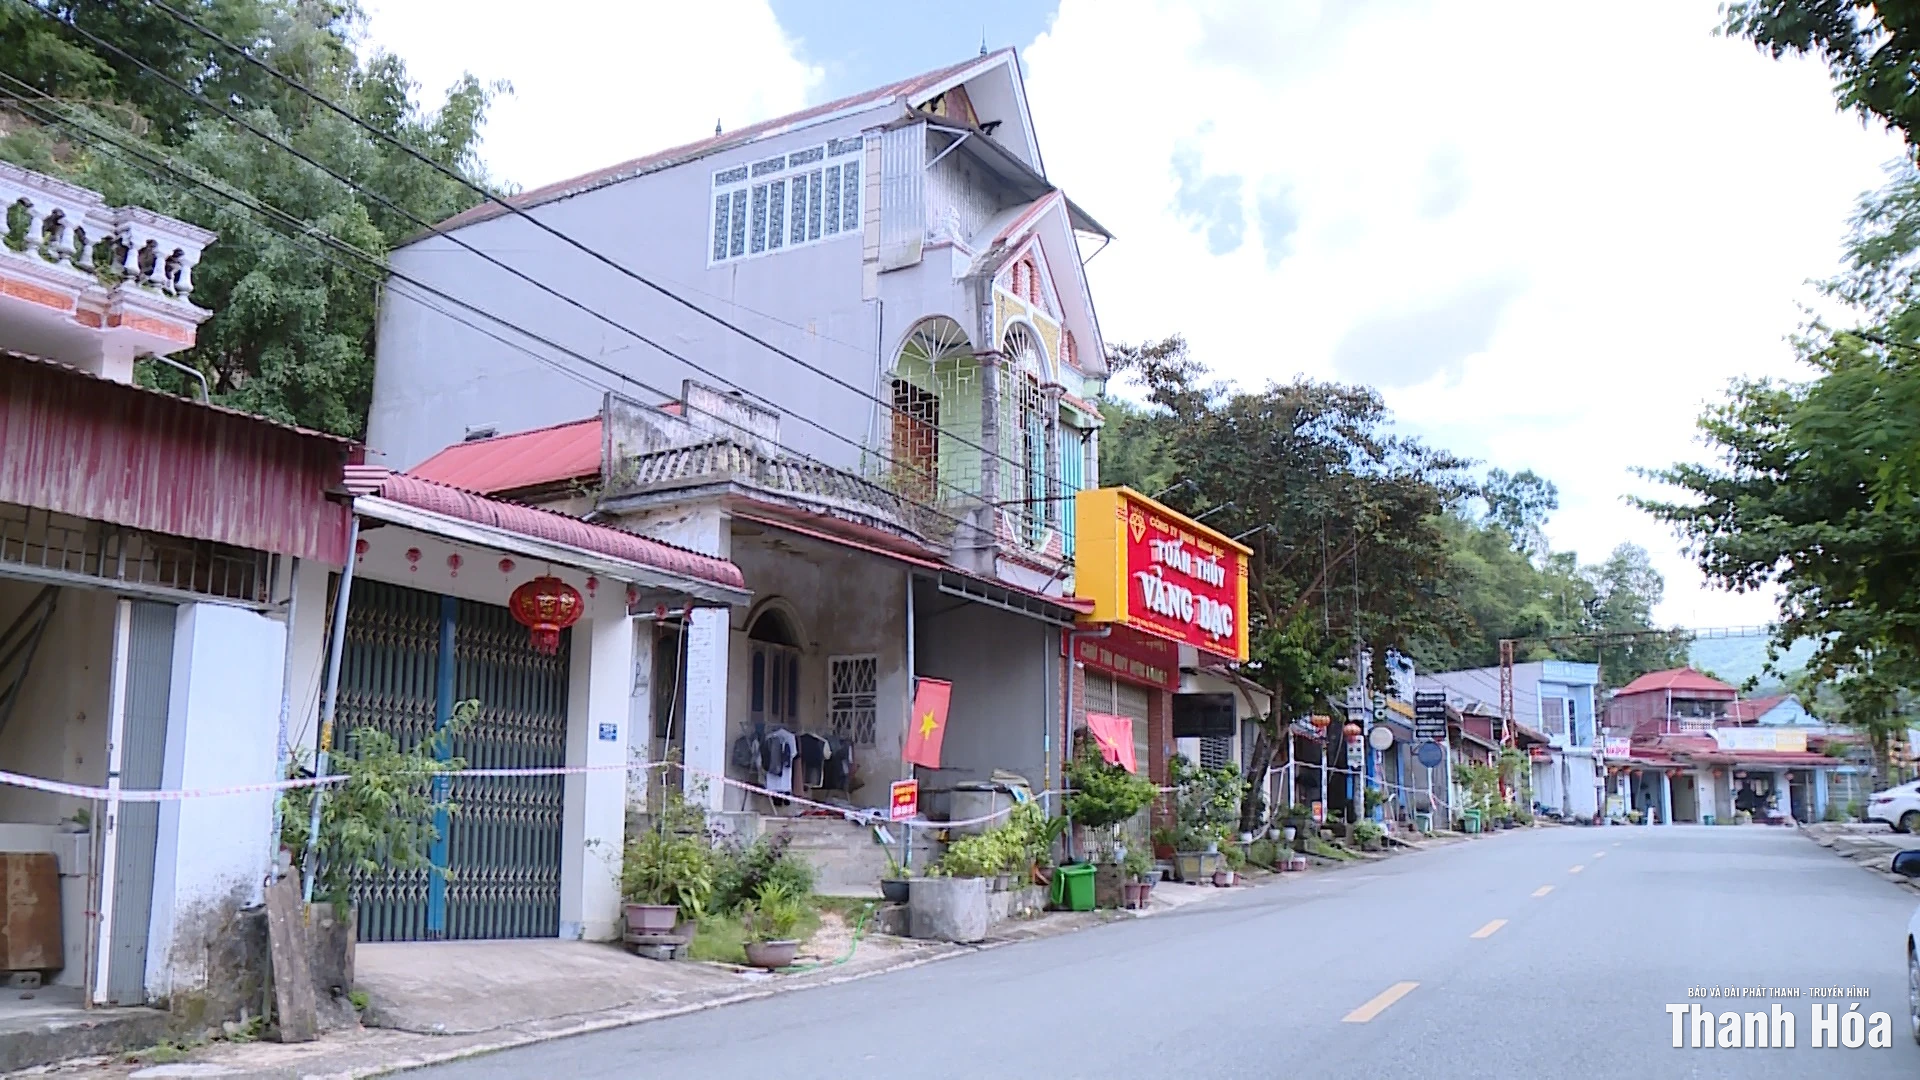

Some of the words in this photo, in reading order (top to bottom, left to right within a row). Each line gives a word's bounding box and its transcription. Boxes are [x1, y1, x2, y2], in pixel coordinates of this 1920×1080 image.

[1150, 538, 1192, 575] TUẤN
[1134, 566, 1194, 624] VÀNG
[1194, 594, 1233, 642] BẠC
